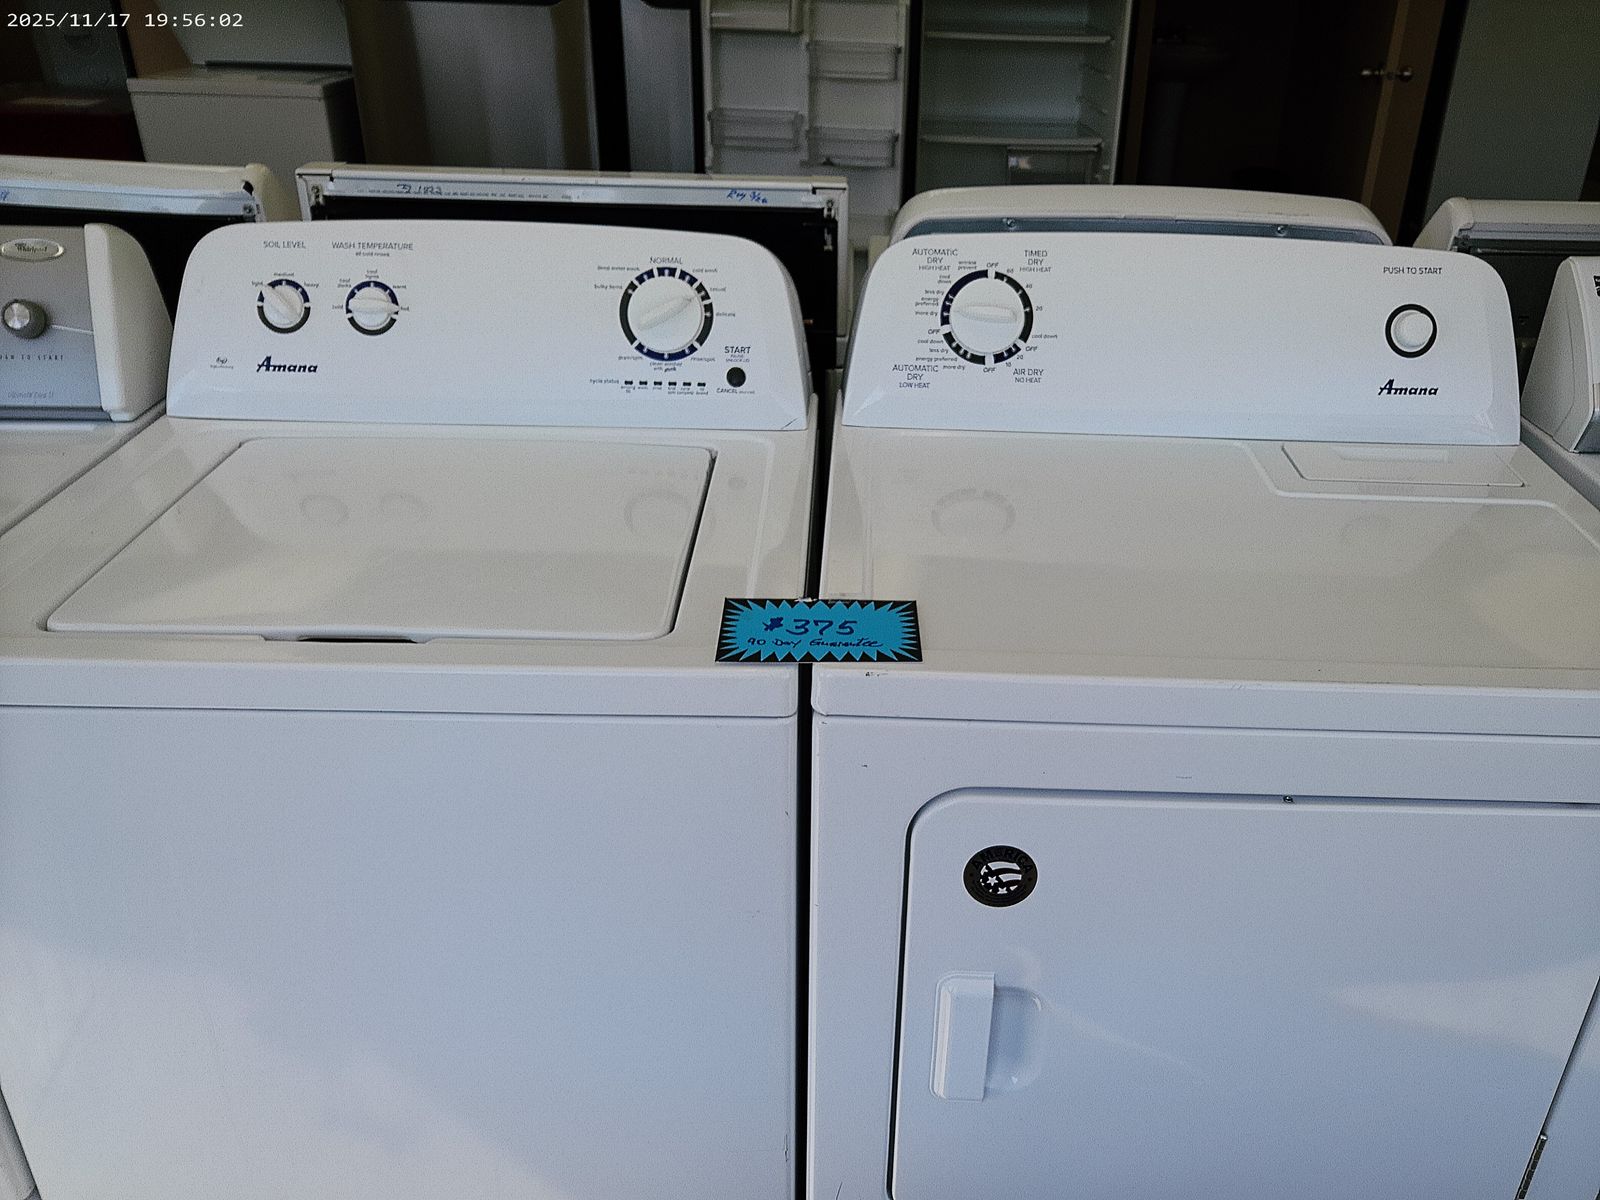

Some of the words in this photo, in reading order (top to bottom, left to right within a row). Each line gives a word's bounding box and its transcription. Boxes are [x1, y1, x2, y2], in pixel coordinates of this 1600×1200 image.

[263, 240, 280, 249] SOIL
[282, 240, 306, 249] LEVEL
[331, 241, 356, 250] WASH
[357, 241, 414, 251] TEMPERATURE
[912, 248, 958, 257] AUTOMATIC
[1024, 249, 1048, 258] TIMED
[649, 256, 683, 265] NORMAL
[926, 256, 943, 264] DRY
[1027, 258, 1044, 266] DRY
[1383, 266, 1405, 274] PUSH
[1406, 266, 1417, 275] TO
[1418, 266, 1442, 275] START
[724, 346, 751, 354] START
[256, 355, 319, 373] Amana
[892, 363, 939, 373] AUTOMATIC
[906, 372, 924, 381] DRY
[1012, 368, 1026, 376] AIR
[1027, 368, 1044, 377] DRY
[1025, 376, 1042, 384] HEAT
[899, 381, 913, 389] LOW
[914, 381, 931, 389] HEAT
[1378, 378, 1438, 396] Amana
[716, 387, 738, 395] CANCEL
[762, 616, 858, 636] $375
[771, 638, 802, 648] Day
